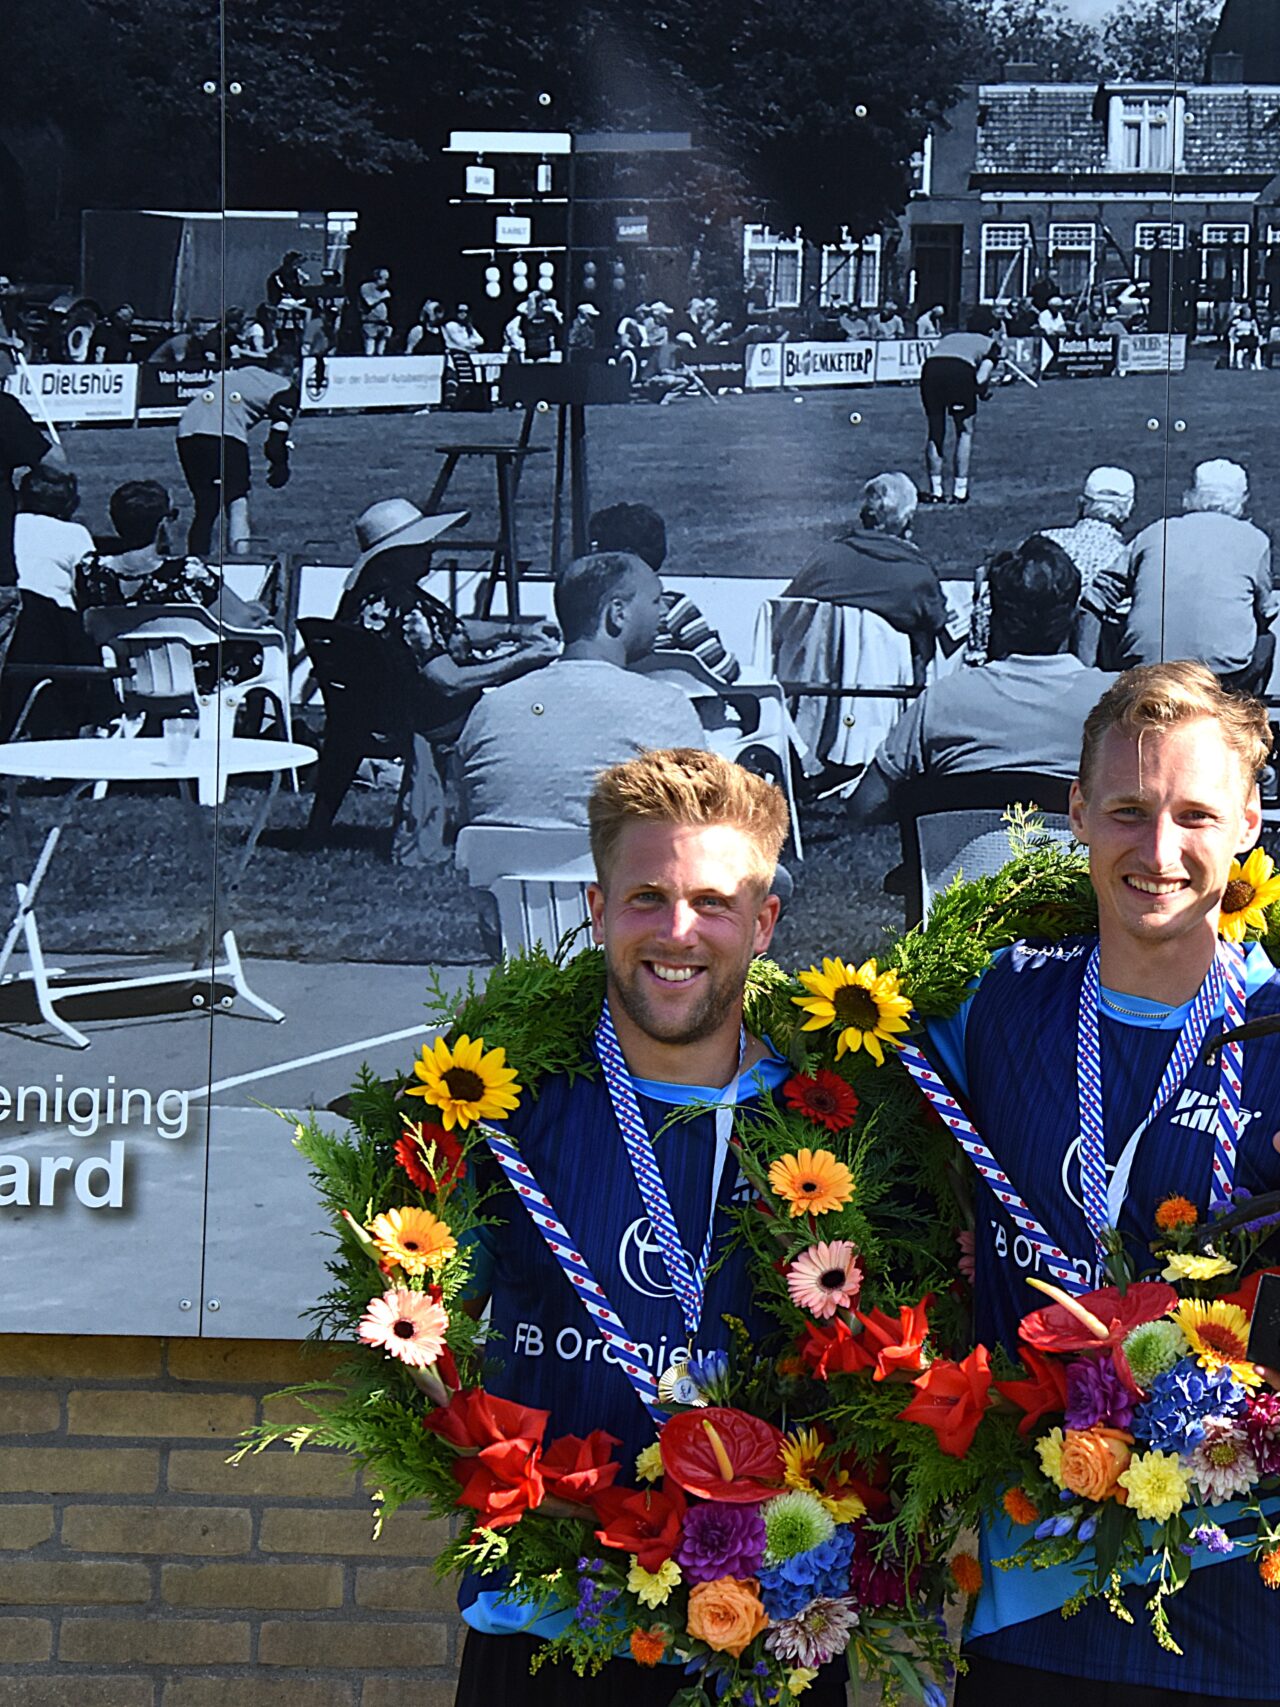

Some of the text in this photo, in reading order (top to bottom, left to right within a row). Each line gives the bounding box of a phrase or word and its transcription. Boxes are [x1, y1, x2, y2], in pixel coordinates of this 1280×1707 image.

[42, 367, 123, 395] Dielshûs
[0, 1074, 189, 1139] eniging
[0, 1140, 125, 1208] ard
[514, 1322, 545, 1356] FB
